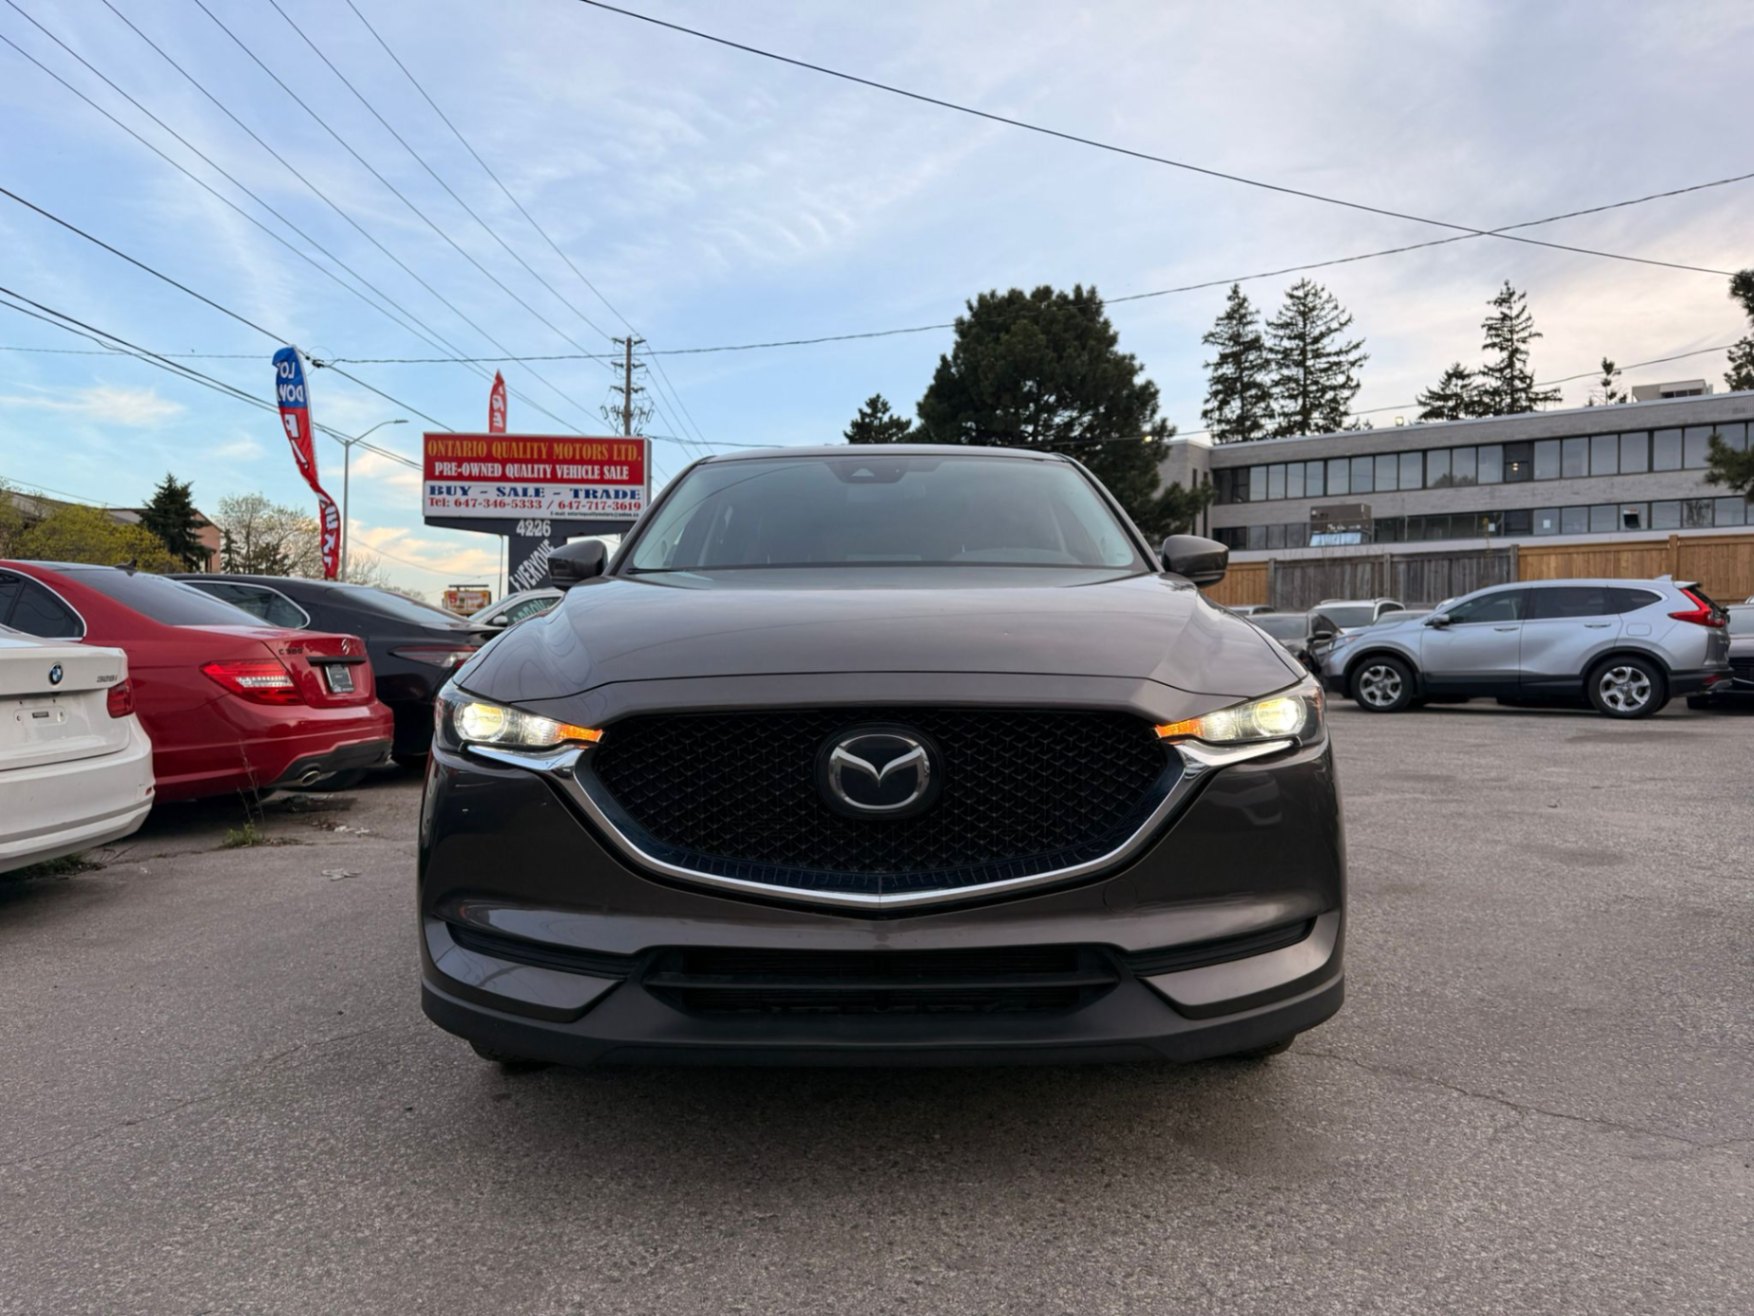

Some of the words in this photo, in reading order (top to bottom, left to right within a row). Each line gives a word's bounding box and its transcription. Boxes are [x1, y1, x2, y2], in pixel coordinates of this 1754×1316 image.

[428, 439, 487, 457] ONTARIO
[492, 441, 548, 459] QUALITY
[553, 442, 609, 460] MOTORS
[613, 444, 642, 461] LTD.
[434, 461, 502, 477] PRE-OWNED
[505, 463, 552, 479] QUALITY
[555, 464, 600, 479] VEHICLE
[603, 465, 629, 480] SALE
[429, 485, 471, 496] BUY
[496, 486, 545, 498] SALE
[569, 488, 640, 500] TRADE
[454, 498, 542, 509] 647-346-5333
[558, 500, 641, 511] 647-717-3619
[516, 519, 551, 537] 4226
